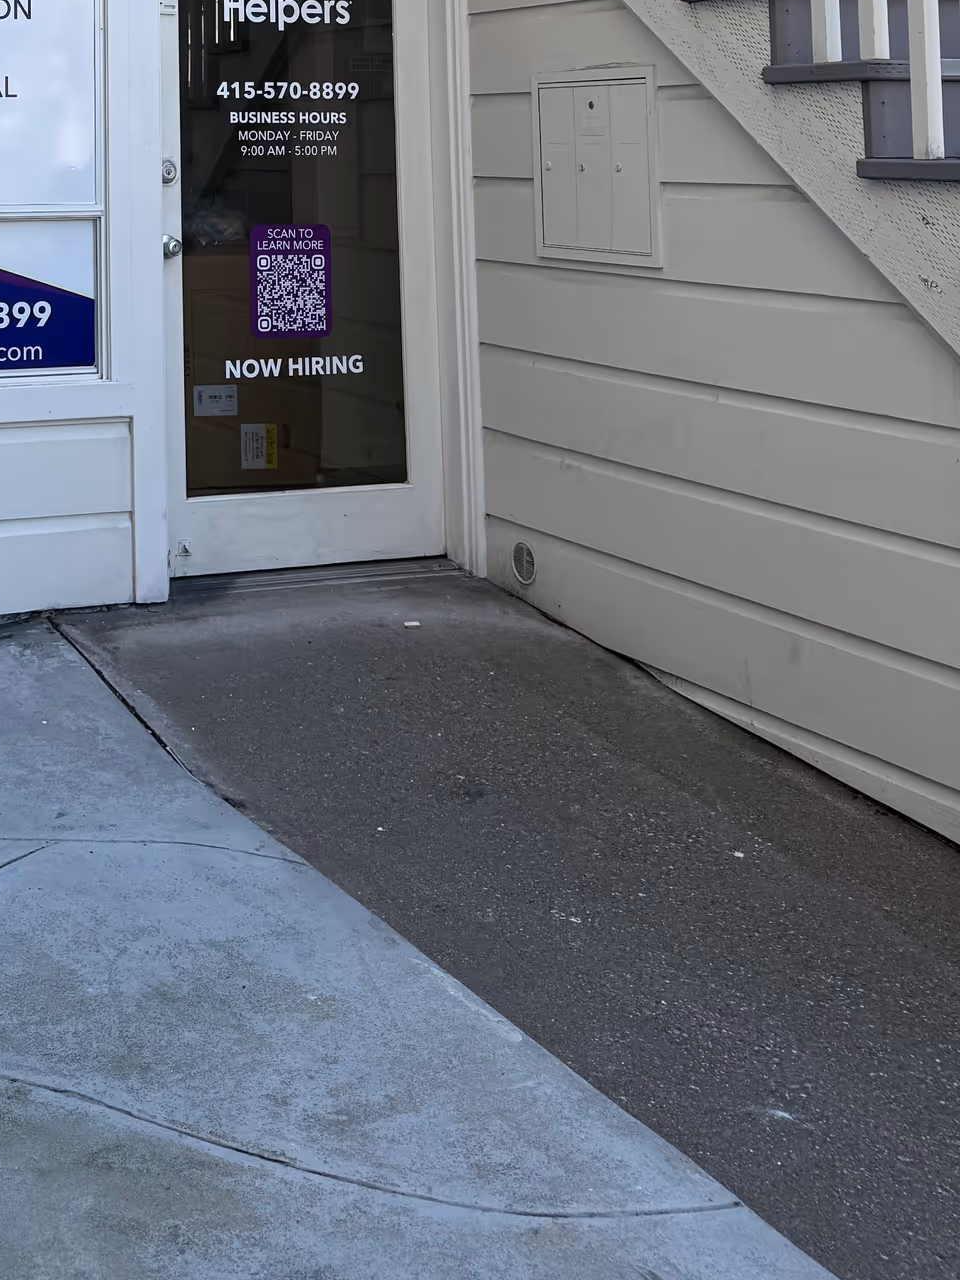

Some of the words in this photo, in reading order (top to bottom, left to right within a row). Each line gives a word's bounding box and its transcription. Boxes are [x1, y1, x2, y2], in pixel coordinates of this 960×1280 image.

[216, 81, 360, 100] 415-570-8899
[229, 111, 296, 124] BUSINESS
[299, 111, 347, 124] HOURS
[238, 130, 291, 141] MONDAY
[299, 130, 340, 141] FRIDAY
[240, 145, 265, 156] 9:00
[266, 145, 285, 156] AM
[294, 145, 318, 156] 5:00
[321, 145, 337, 156] PM
[267, 229, 296, 239] SCAN
[298, 228, 313, 239] TO
[257, 240, 290, 251] LEARN
[293, 240, 324, 250] MORE
[225, 358, 282, 379] NOW
[288, 354, 364, 376] HIRING
